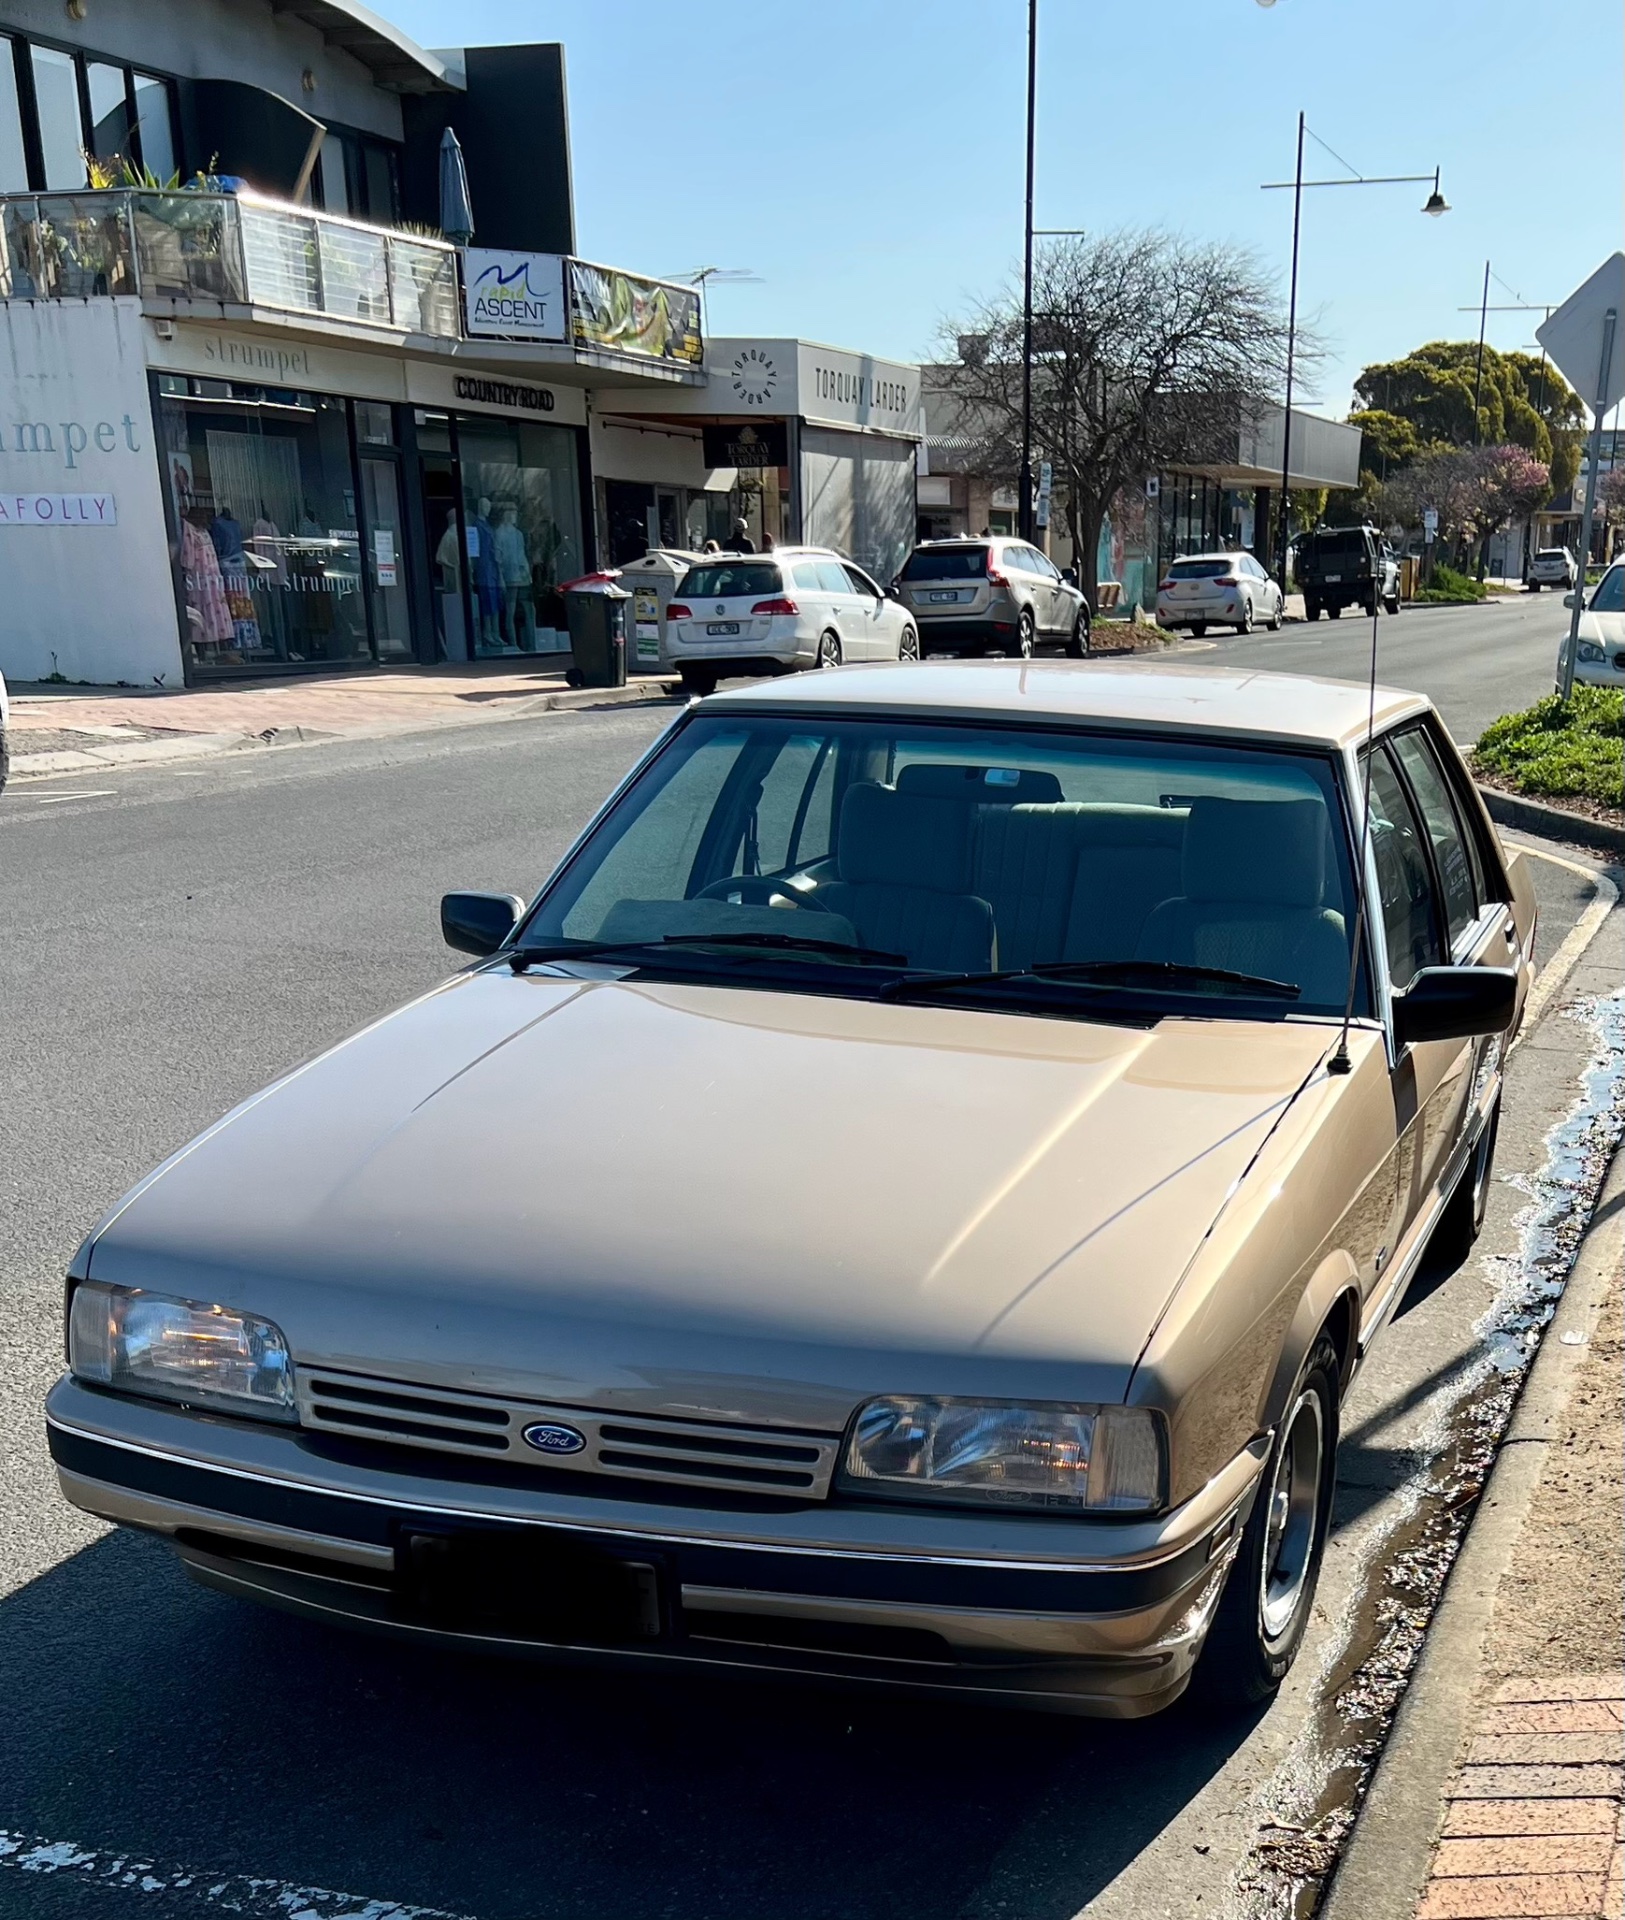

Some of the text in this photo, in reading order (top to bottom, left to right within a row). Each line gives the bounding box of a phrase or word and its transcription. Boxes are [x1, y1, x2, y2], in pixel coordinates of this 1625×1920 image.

[475, 297, 547, 320] ASCENT
[481, 281, 526, 301] rapid
[204, 337, 309, 381] strumpet
[453, 374, 555, 412] COUNTRY ROAD
[815, 367, 907, 413] TORQUAY LARDER
[0, 414, 141, 469] mpet
[538, 1430, 569, 1446] Ford
